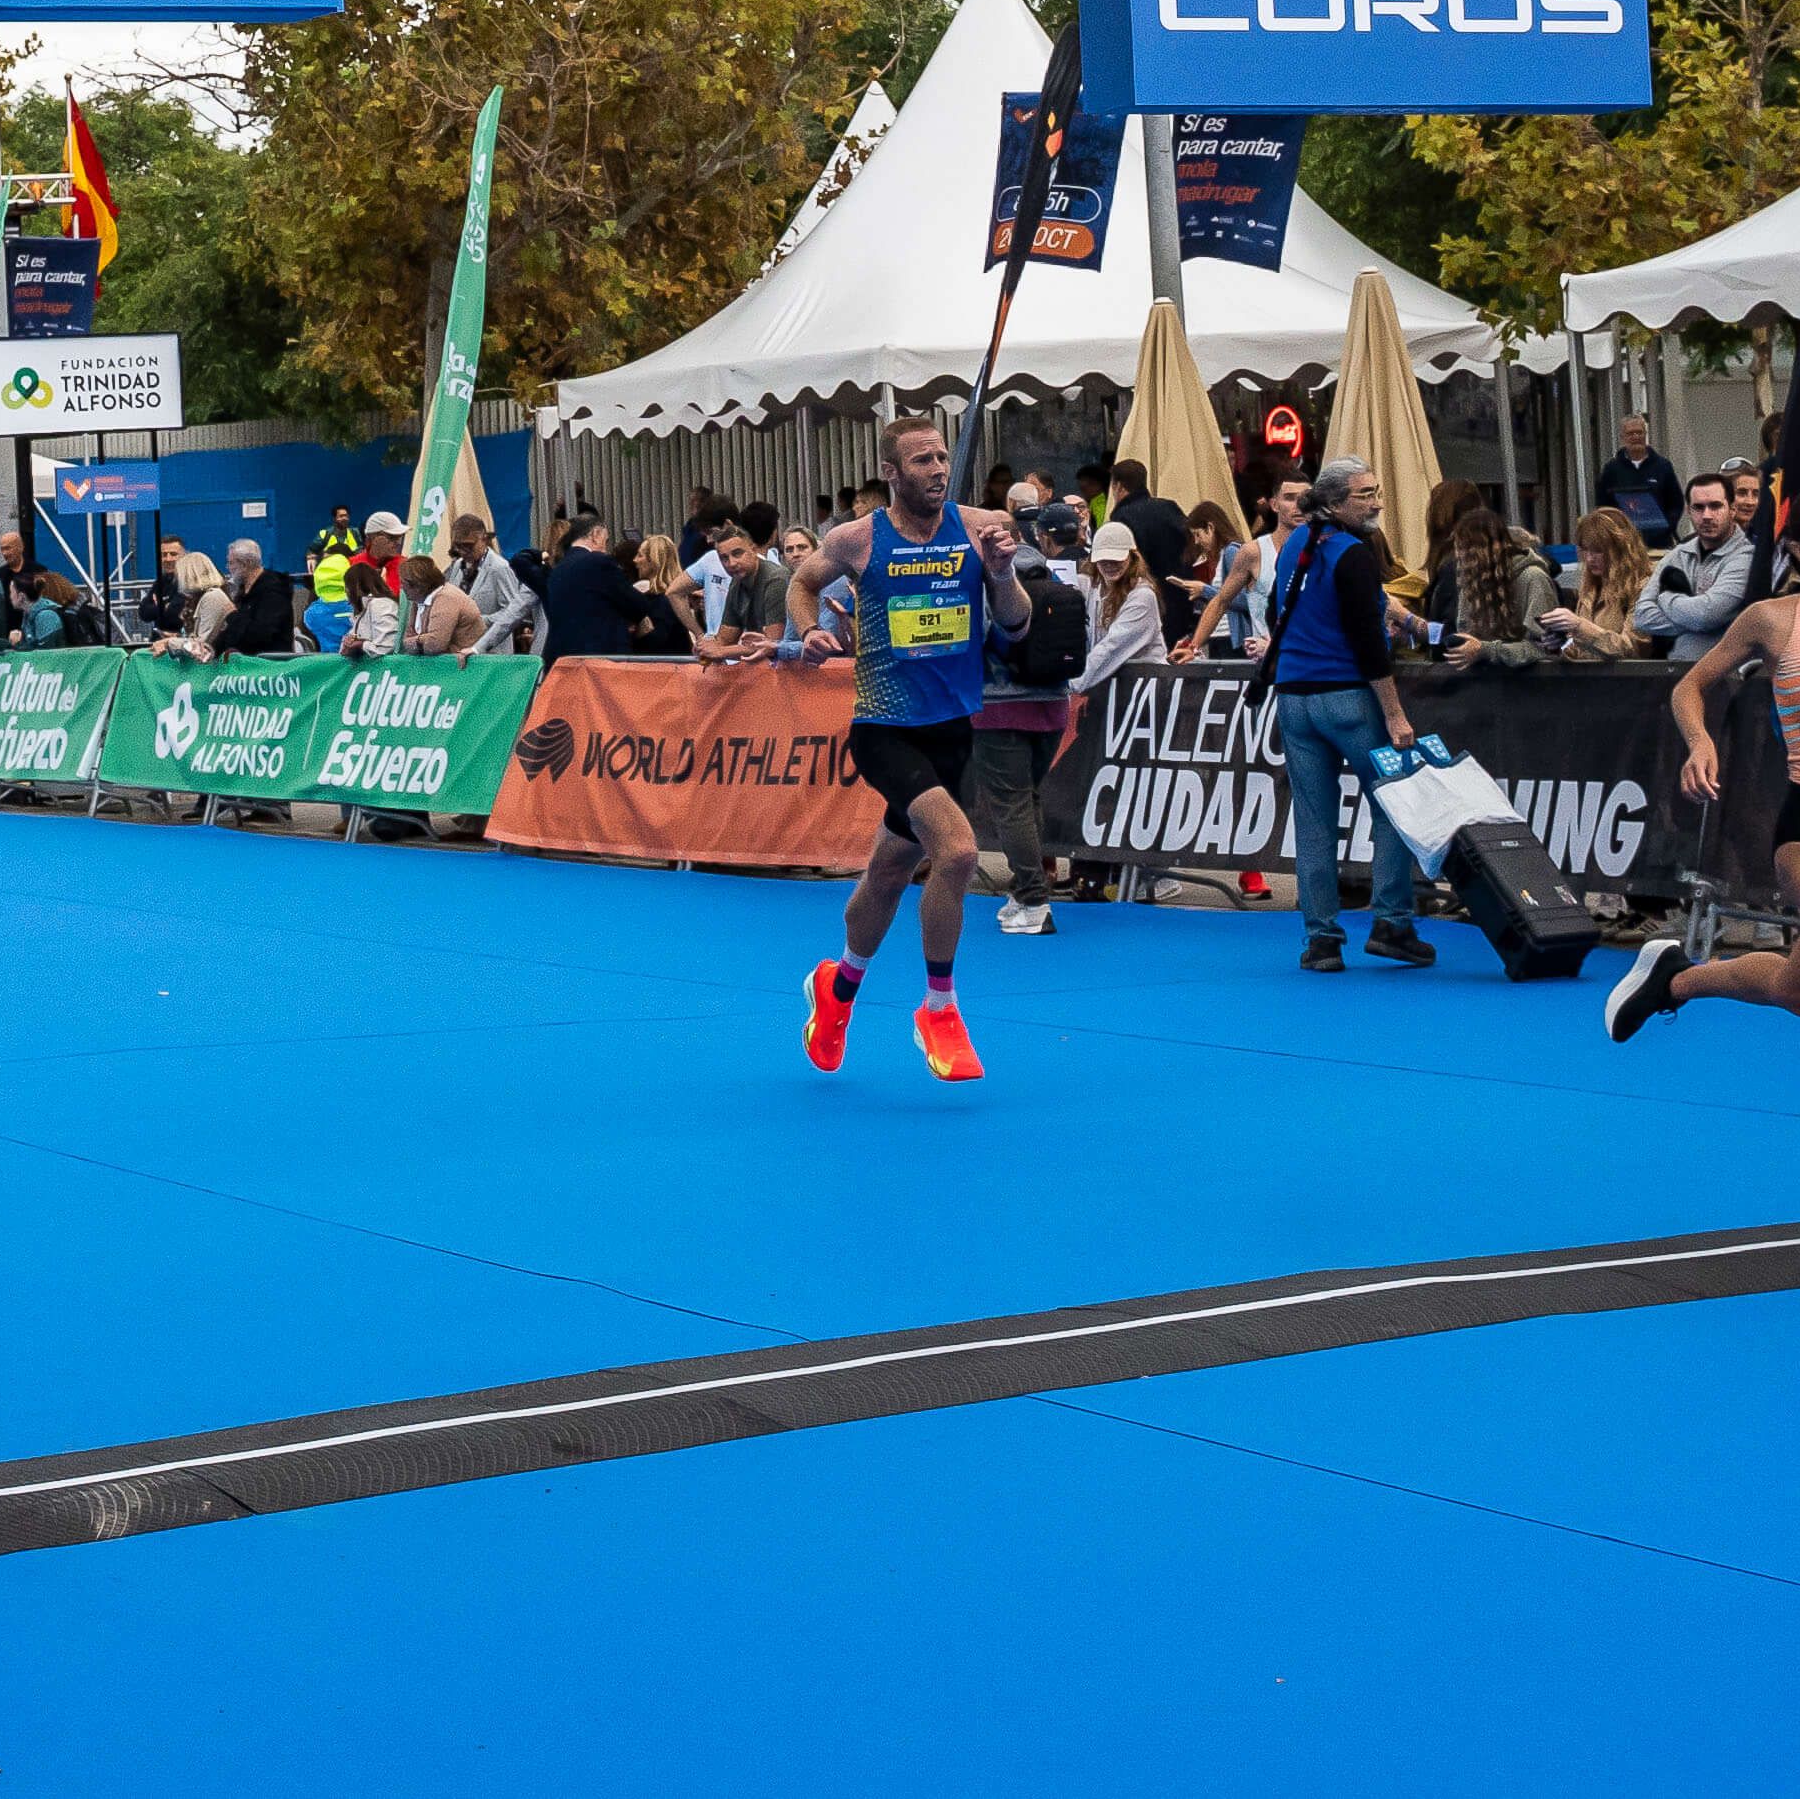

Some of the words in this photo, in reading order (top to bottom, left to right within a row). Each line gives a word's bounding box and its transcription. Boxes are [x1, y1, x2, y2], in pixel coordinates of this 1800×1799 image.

[1177, 139, 1215, 161] para
[1220, 138, 1285, 161] cantar,
[1032, 226, 1079, 250] OCT
[60, 355, 159, 370] FUNDACIÓN
[60, 372, 161, 391] TRINIDAD
[63, 392, 162, 412] ALFONSO
[918, 613, 941, 626] 521
[209, 672, 300, 698] FUNDACIÓN
[341, 668, 441, 728] Cultura
[435, 697, 463, 728] del
[205, 702, 293, 739] TRINIDAD
[190, 741, 285, 779] ALFONSO
[317, 728, 448, 796] Esfuerzo
[582, 731, 695, 786] WORLD
[701, 734, 861, 788] ATHLETIC
[1081, 766, 1276, 856] CIUDAD
